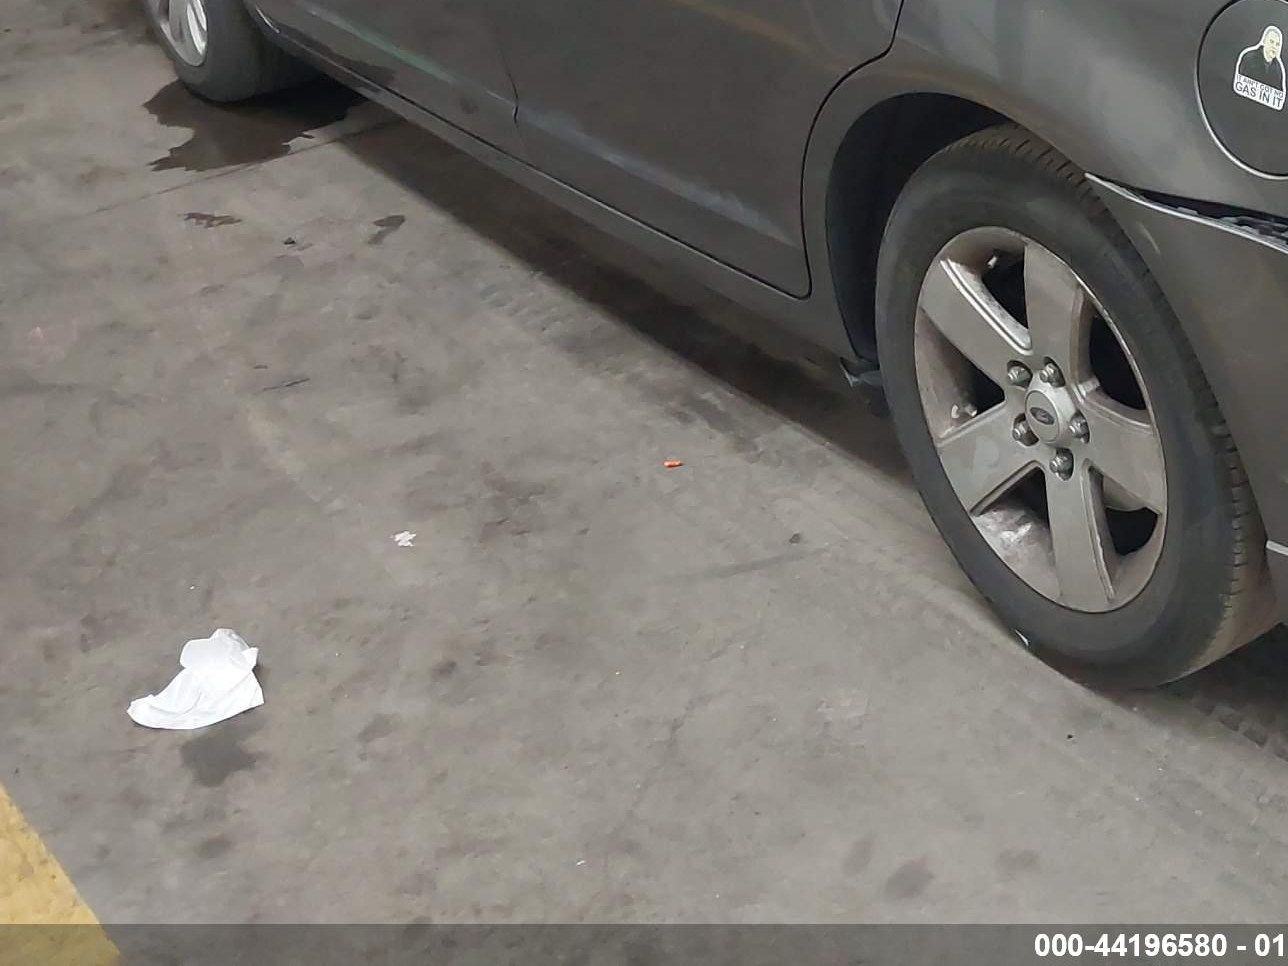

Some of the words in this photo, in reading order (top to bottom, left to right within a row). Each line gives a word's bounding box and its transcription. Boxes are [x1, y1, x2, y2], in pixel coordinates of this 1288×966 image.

[1235, 81, 1257, 97] GAS
[1259, 90, 1270, 103] IN
[1272, 96, 1283, 107] IT
